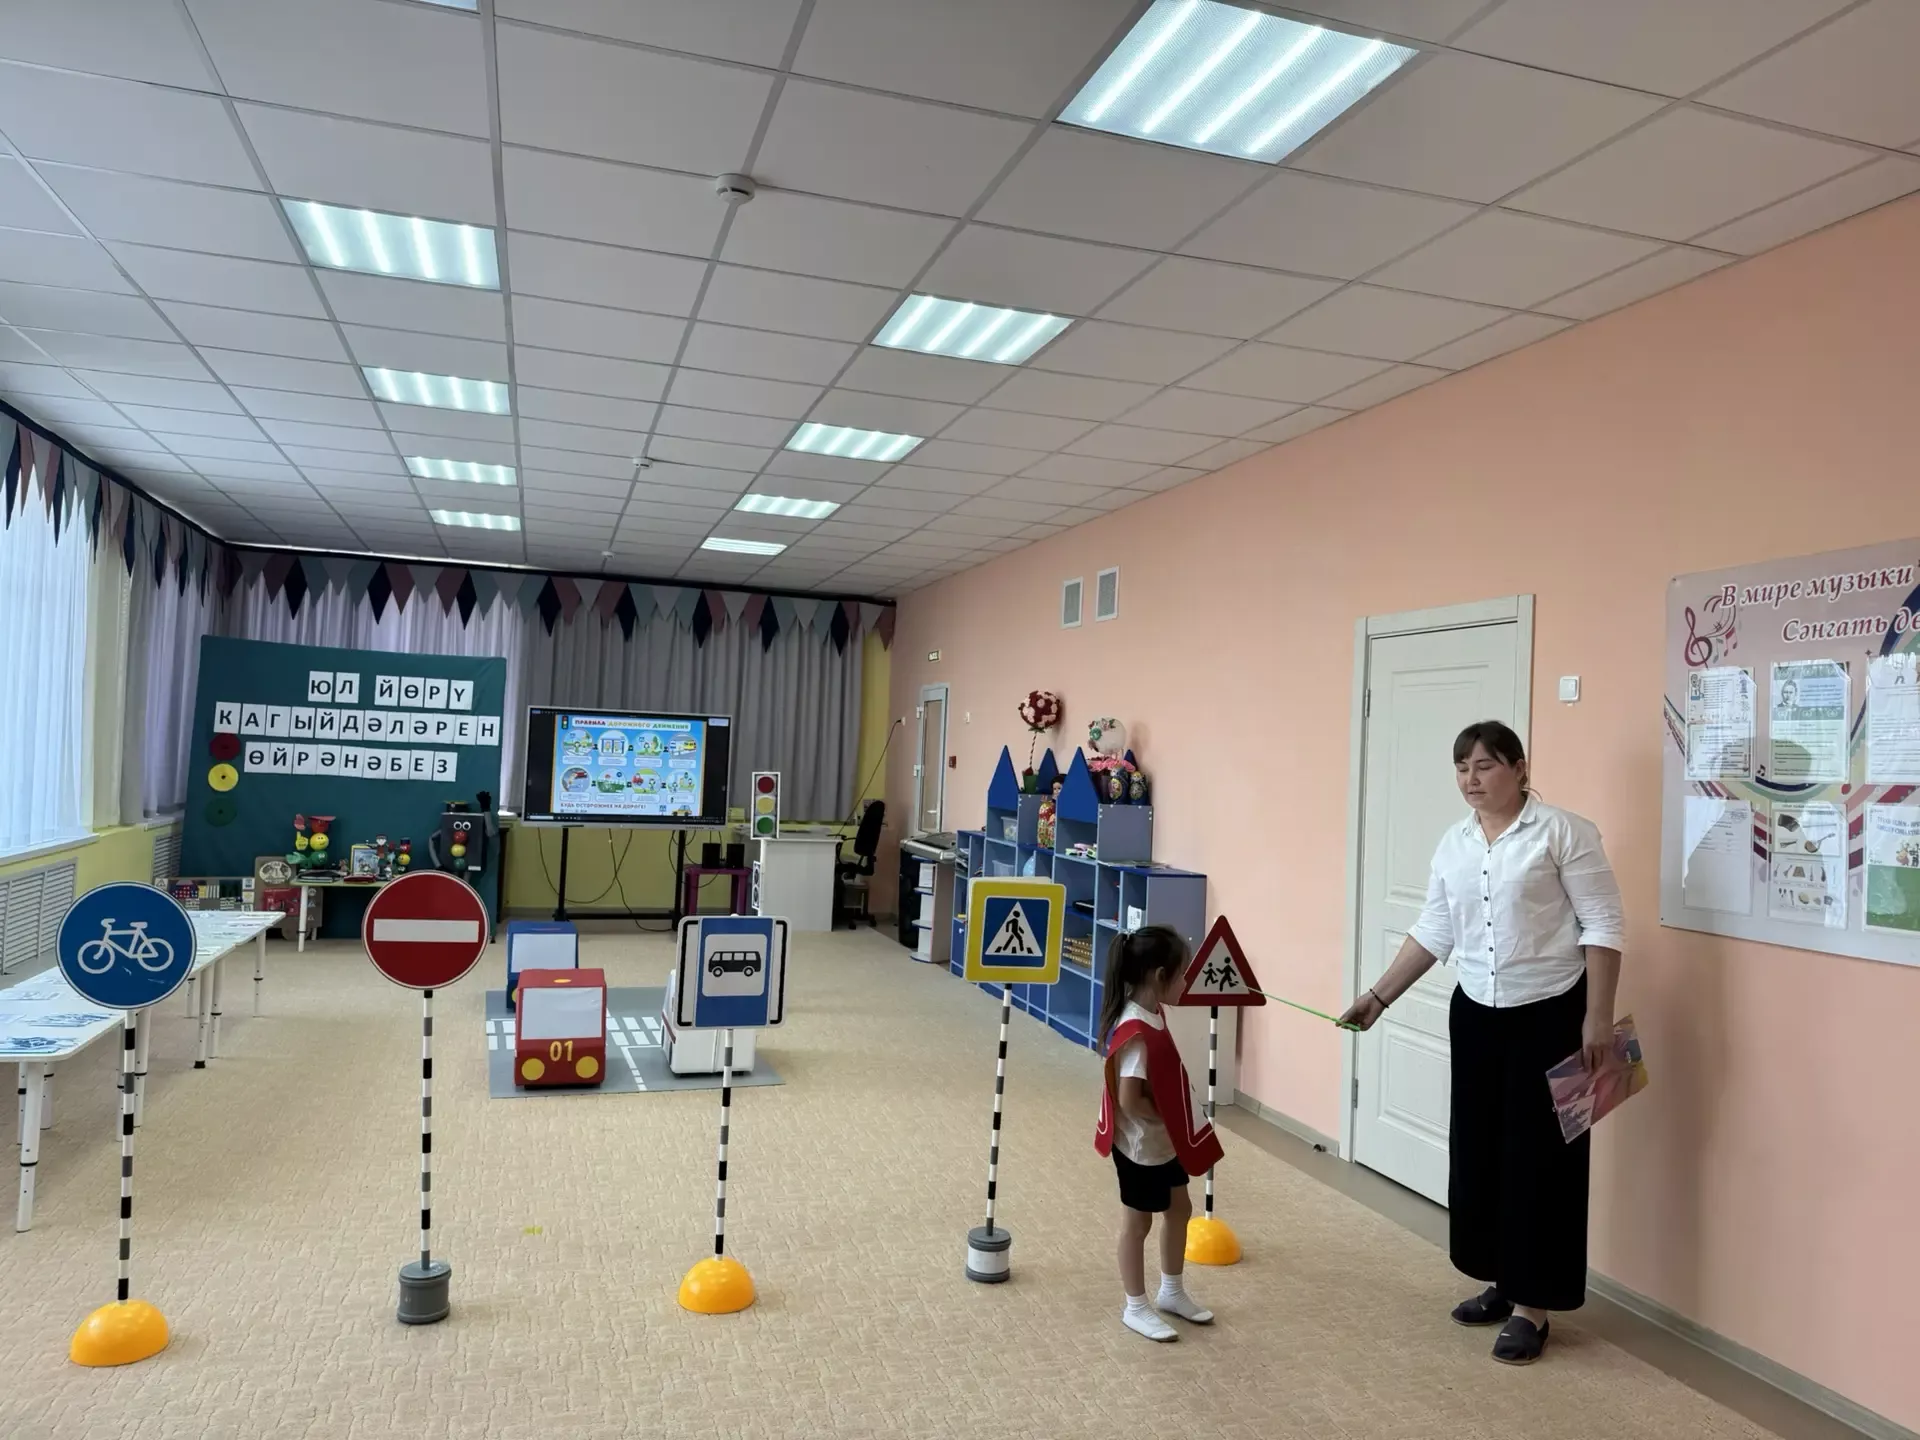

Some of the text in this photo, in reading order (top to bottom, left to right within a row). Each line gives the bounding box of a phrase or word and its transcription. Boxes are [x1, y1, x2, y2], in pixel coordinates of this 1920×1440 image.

[1722, 566, 1912, 608] В мире музыки
[1783, 616, 1888, 642] Сәнгать
[310, 679, 466, 703] ЮЛ ЙӨРҮ
[218, 709, 495, 737] КАГЫЙДӘЛӘРЕН
[607, 720, 651, 728] ДОРОЖНОГО
[248, 748, 448, 774] ӨЙРӘНӘБЕЗ
[549, 1039, 574, 1062] 01
